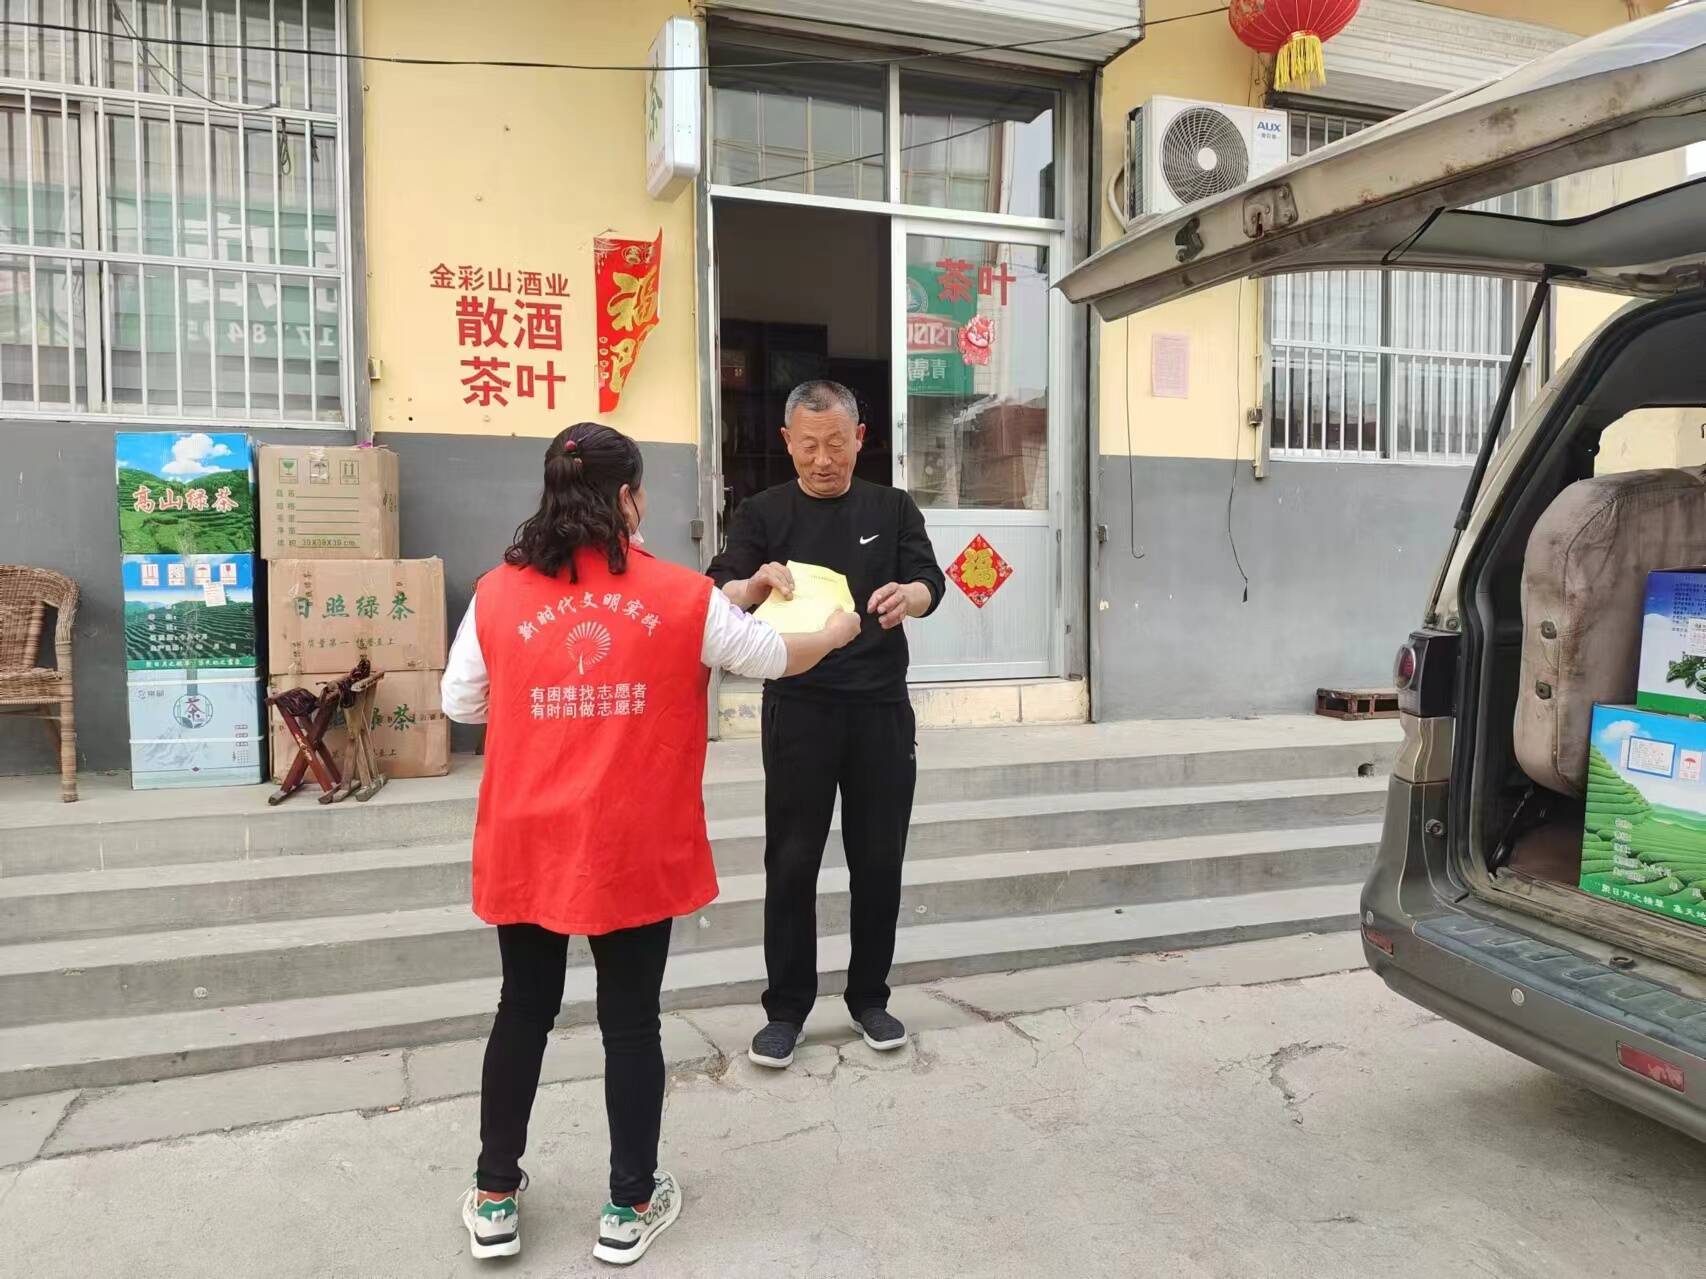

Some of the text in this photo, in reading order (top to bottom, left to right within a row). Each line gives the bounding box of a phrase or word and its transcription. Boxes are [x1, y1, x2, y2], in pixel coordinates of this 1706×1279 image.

[1257, 121, 1281, 132] AUX
[429, 263, 570, 297] 金彩山酒业
[936, 258, 1016, 306] 茶叶
[456, 295, 562, 351] 散酒
[460, 356, 566, 410] 茶叶
[961, 548, 997, 588] 福
[293, 593, 415, 621] 日照绿茶
[517, 592, 661, 641] 新时代文明实践
[530, 683, 647, 702] 有困难找志愿者
[530, 700, 647, 719] 有时间做志愿者
